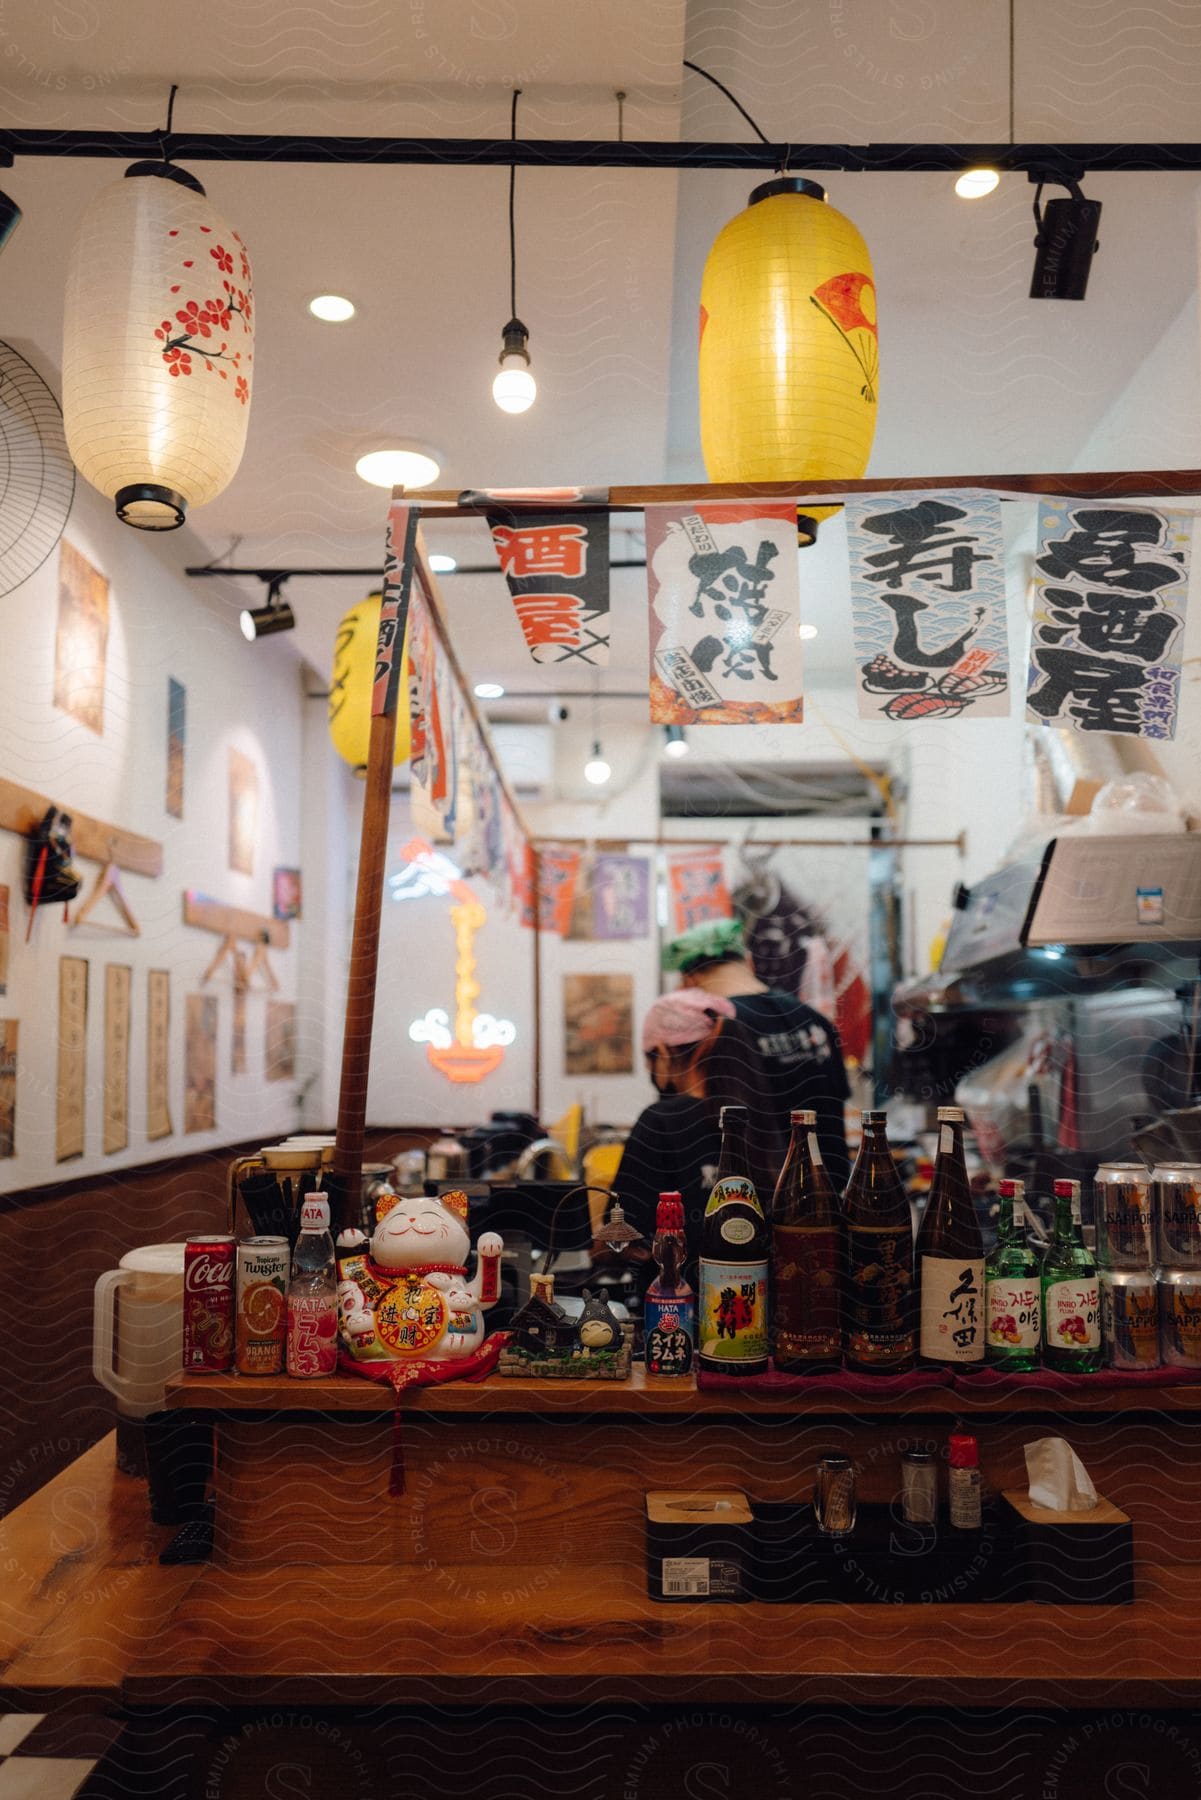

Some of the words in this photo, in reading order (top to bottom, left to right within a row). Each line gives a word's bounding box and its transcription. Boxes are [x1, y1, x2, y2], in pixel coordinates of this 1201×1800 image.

[861, 500, 993, 668] 寿し
[1026, 508, 1184, 734] 居酒屋
[186, 1254, 233, 1293] Coca
[244, 1261, 288, 1277] Twister
[292, 1298, 327, 1312] HATA
[658, 1305, 679, 1313] HATA
[943, 1268, 978, 1348] 久保田
[1057, 1300, 1077, 1308] JINRO
[380, 1305, 398, 1325] 进
[423, 1305, 440, 1326] 宝
[297, 1313, 321, 1375] ラムネ
[400, 1326, 417, 1346] 财
[652, 1333, 686, 1347] スイカ
[652, 1346, 687, 1361] ラムネ
